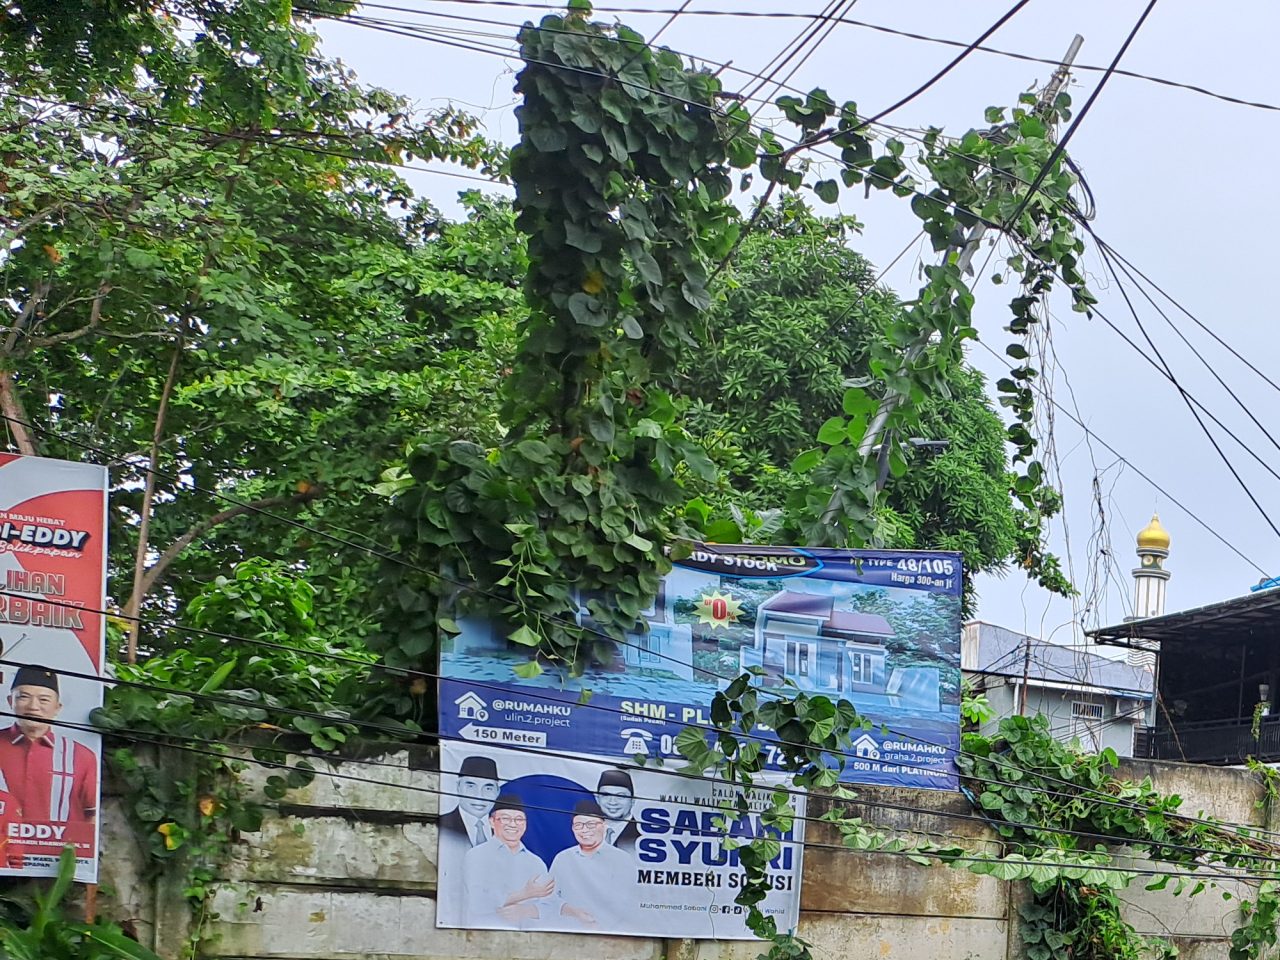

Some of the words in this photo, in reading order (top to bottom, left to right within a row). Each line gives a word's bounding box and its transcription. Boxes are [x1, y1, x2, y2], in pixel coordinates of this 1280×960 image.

[9, 513, 35, 522] MAJU
[36, 517, 66, 526] HEBAT
[0, 522, 87, 548] I-EDDY
[723, 557, 778, 572] STOCK
[867, 559, 894, 567] TYPE
[896, 559, 954, 576] 48/105
[0, 569, 65, 596] IHAN
[891, 572, 915, 585] Harga
[916, 575, 944, 587] 300-an
[492, 699, 571, 716] @RUMAHKU
[473, 728, 498, 740] 150
[502, 733, 542, 744] Meter
[882, 740, 947, 755] @RUMAHKU
[853, 762, 871, 770] 500
[872, 763, 881, 772] M
[882, 765, 900, 774] dari
[712, 788, 740, 799] CALON
[8, 823, 66, 840] EDDY
[637, 869, 722, 888] MEMBERI
